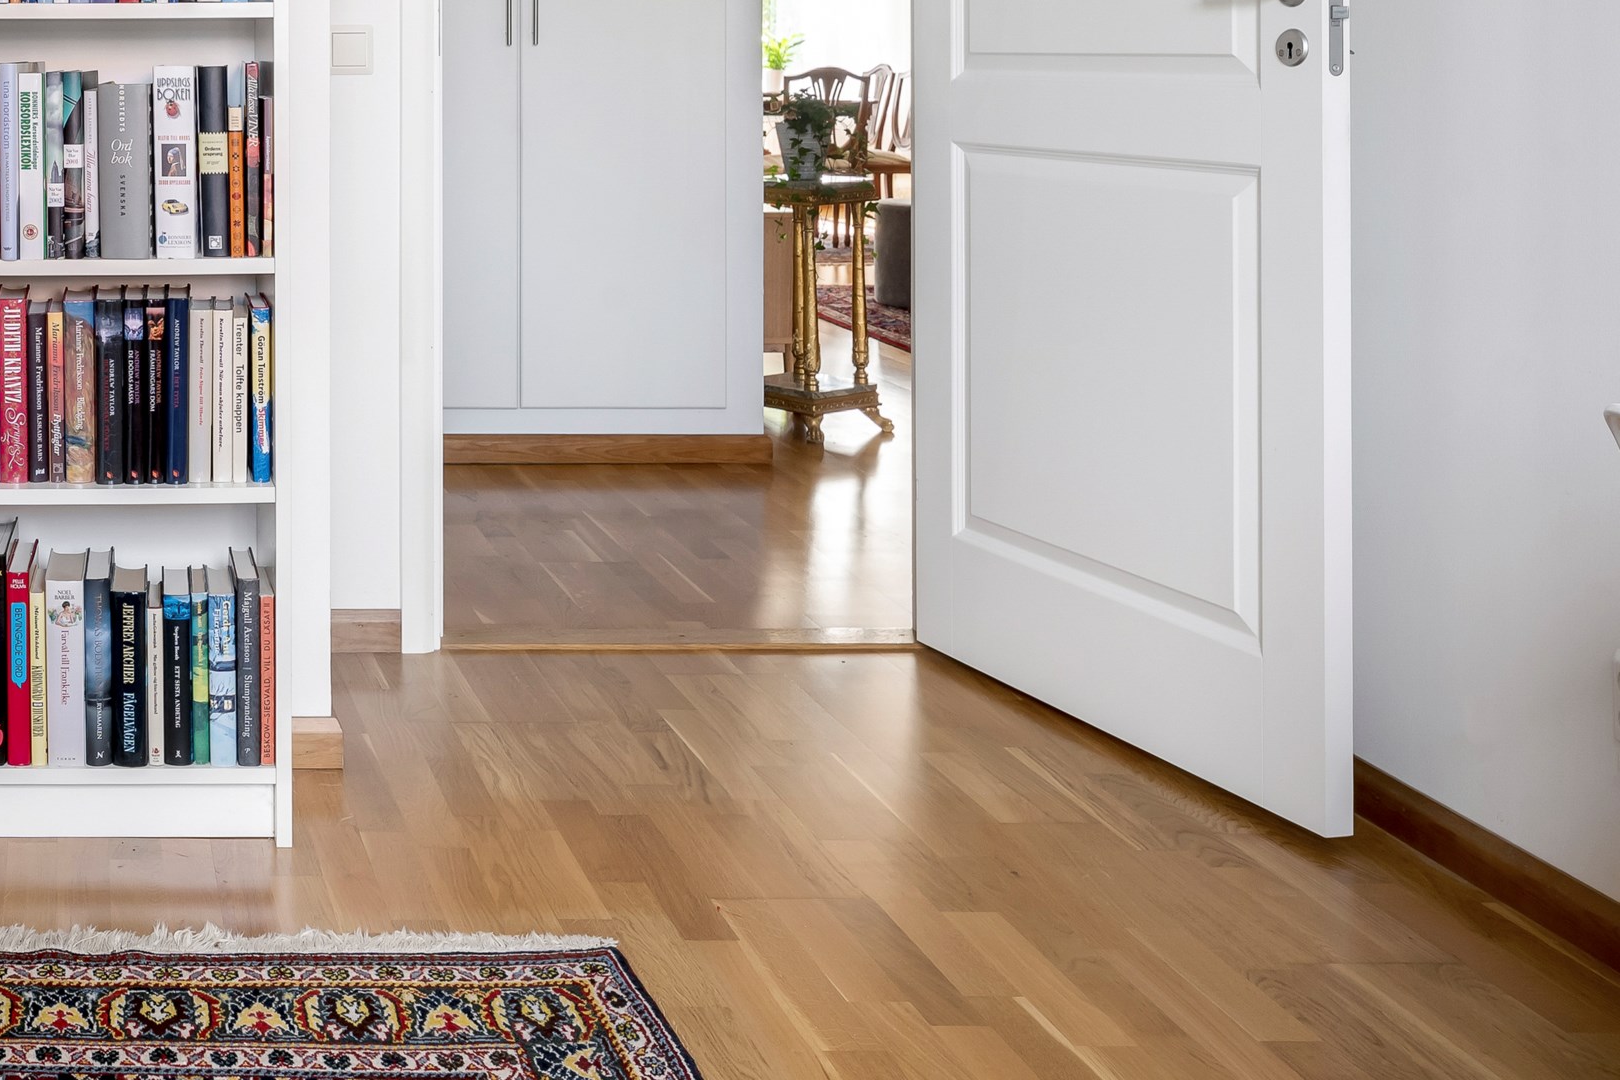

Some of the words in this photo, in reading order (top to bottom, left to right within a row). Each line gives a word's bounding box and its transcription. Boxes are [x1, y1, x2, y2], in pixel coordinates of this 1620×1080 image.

[3, 81, 11, 99] tina
[3, 102, 11, 149] nordström
[20, 91, 31, 170] KORSORDSLEXIKON
[111, 139, 132, 151] Ord
[110, 152, 133, 167] bok
[3, 306, 21, 352] JUDITH
[236, 322, 244, 356] Trenter
[257, 336, 265, 361] Göran
[4, 358, 21, 404] KRANTZ
[236, 364, 244, 390] Tolfte
[258, 363, 266, 404] Tunström
[235, 393, 244, 433] knappen
[122, 603, 134, 643] JEFFREY
[243, 592, 252, 624] Majgull
[14, 607, 24, 658] BEVINGADE
[244, 626, 252, 663] Axelsson
[14, 660, 23, 678] ORD
[122, 645, 134, 684] ARCHER
[123, 693, 137, 752] FÅGELVÄGEN
[243, 675, 252, 737] Slumpvandring
